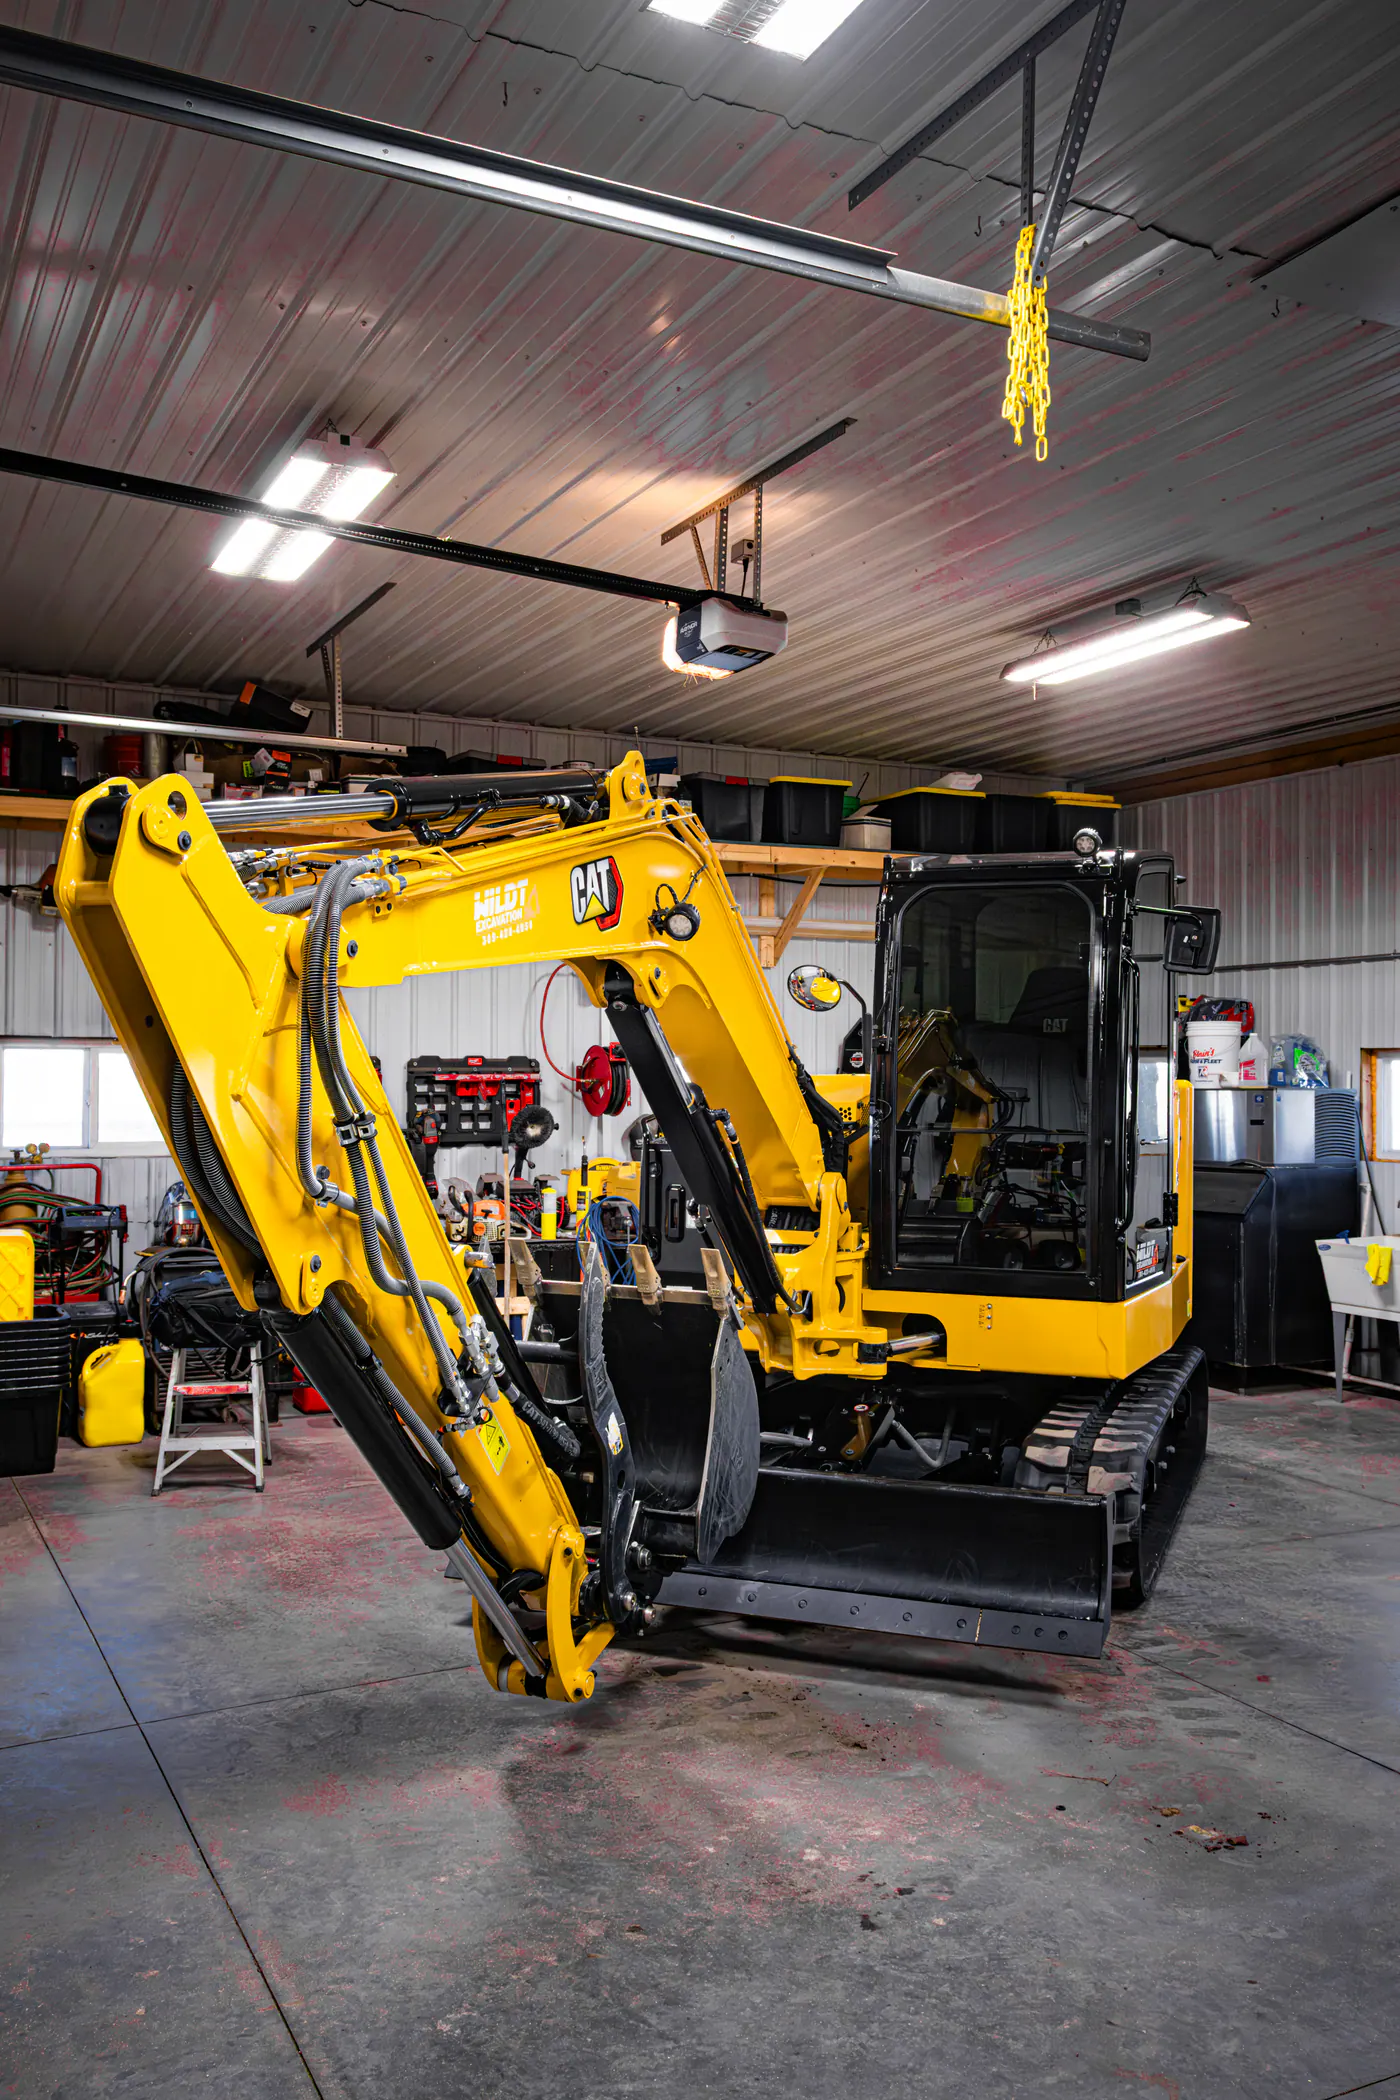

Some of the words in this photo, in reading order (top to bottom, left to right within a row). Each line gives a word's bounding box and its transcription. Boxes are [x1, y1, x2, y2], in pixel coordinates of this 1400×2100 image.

[474, 878, 528, 920] WILDT
[571, 858, 610, 923] CAT
[475, 907, 523, 933] EXCAVATION
[1043, 1018, 1069, 1033] CAT
[522, 1400, 541, 1421] CAT
